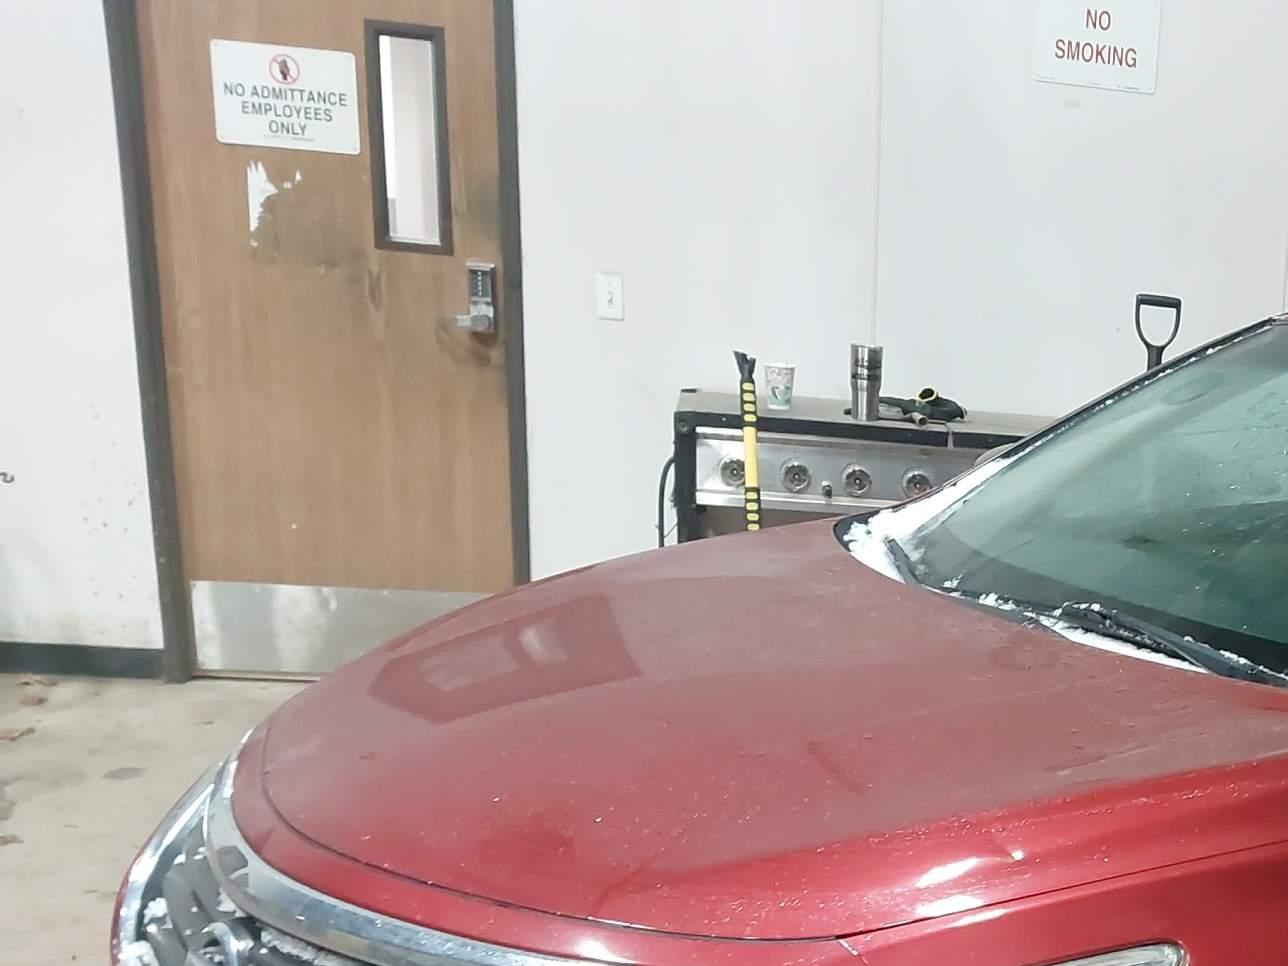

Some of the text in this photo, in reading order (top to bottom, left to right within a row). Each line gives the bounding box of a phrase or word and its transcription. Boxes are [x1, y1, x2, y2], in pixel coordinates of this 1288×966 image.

[1085, 8, 1111, 31] NO
[1054, 38, 1137, 69] SMOKING
[223, 82, 348, 107] NO ADMITTANCE
[241, 101, 333, 122] EMPLOYEES
[268, 120, 307, 136] ONLY
